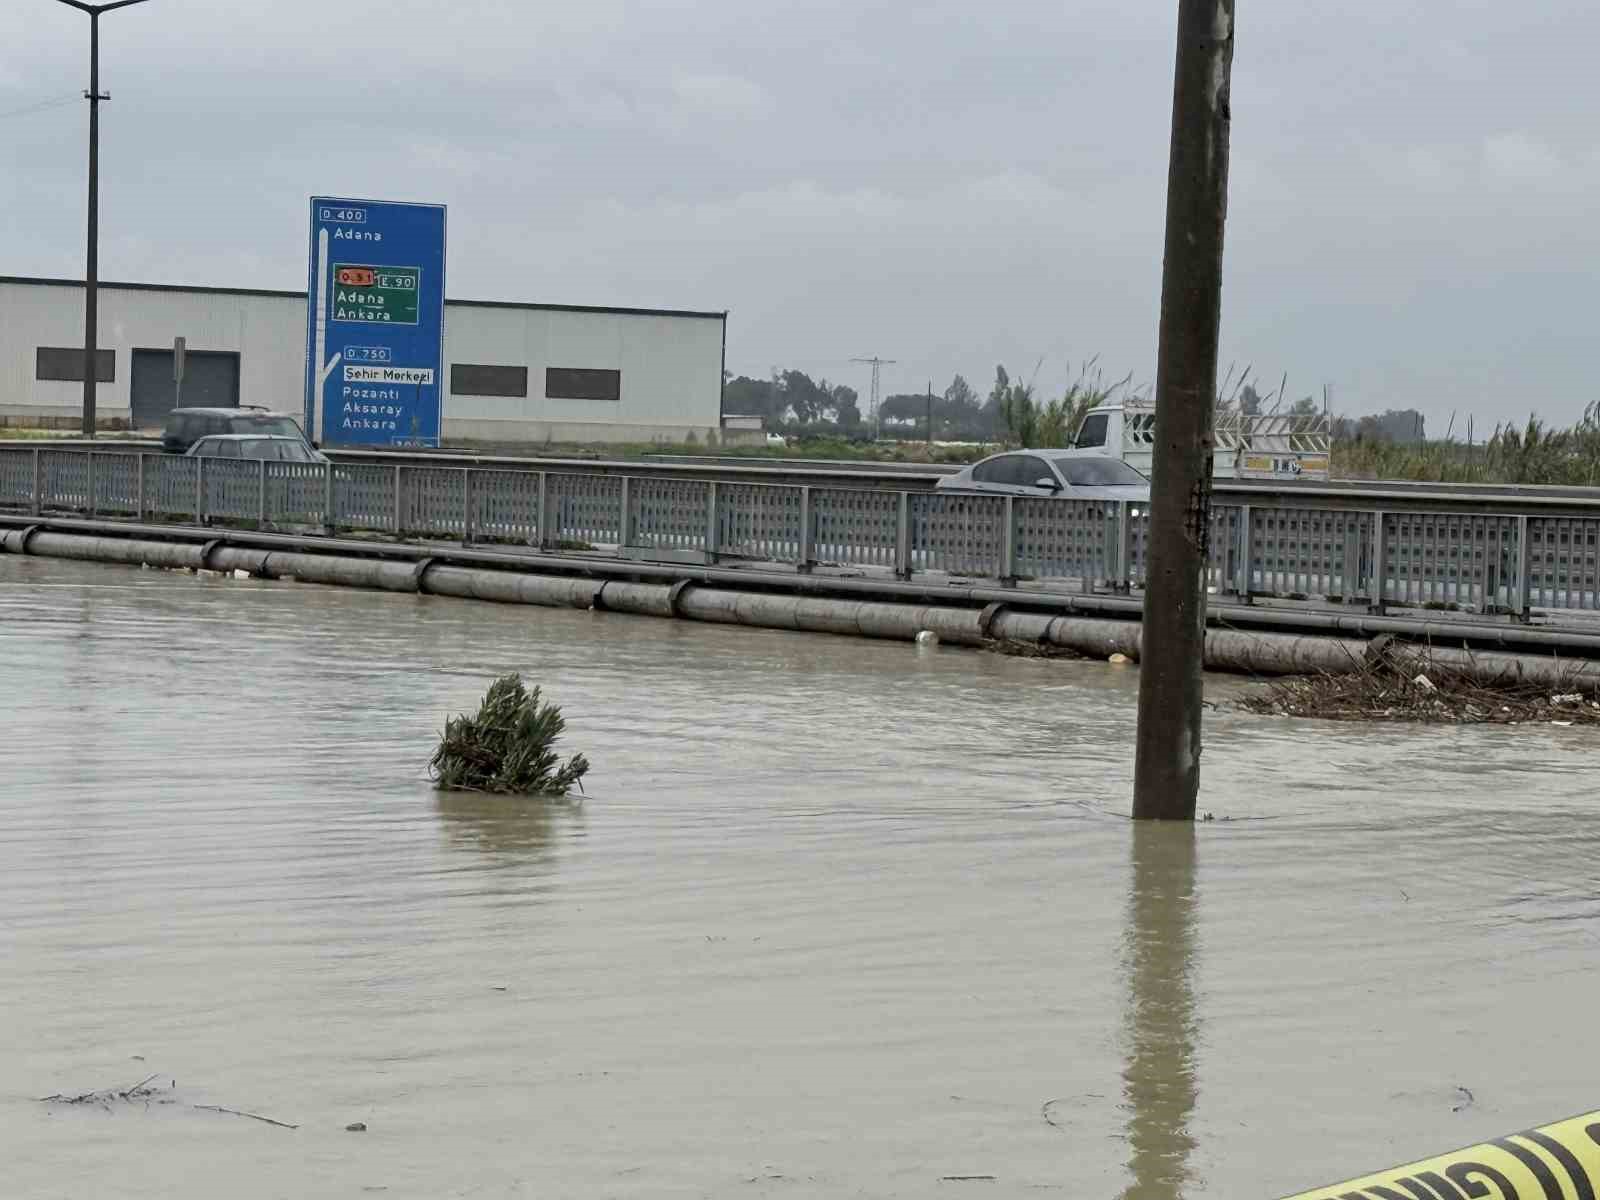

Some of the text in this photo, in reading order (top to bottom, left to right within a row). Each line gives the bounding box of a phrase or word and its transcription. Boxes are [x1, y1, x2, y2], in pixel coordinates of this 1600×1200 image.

[334, 227, 382, 241] Adana
[337, 291, 385, 304] Adana
[337, 307, 391, 321] Ankara
[384, 369, 430, 382] Merkezi
[343, 387, 399, 400] Pozantı
[343, 402, 402, 418] Aksaray
[343, 418, 396, 429] Ankara
